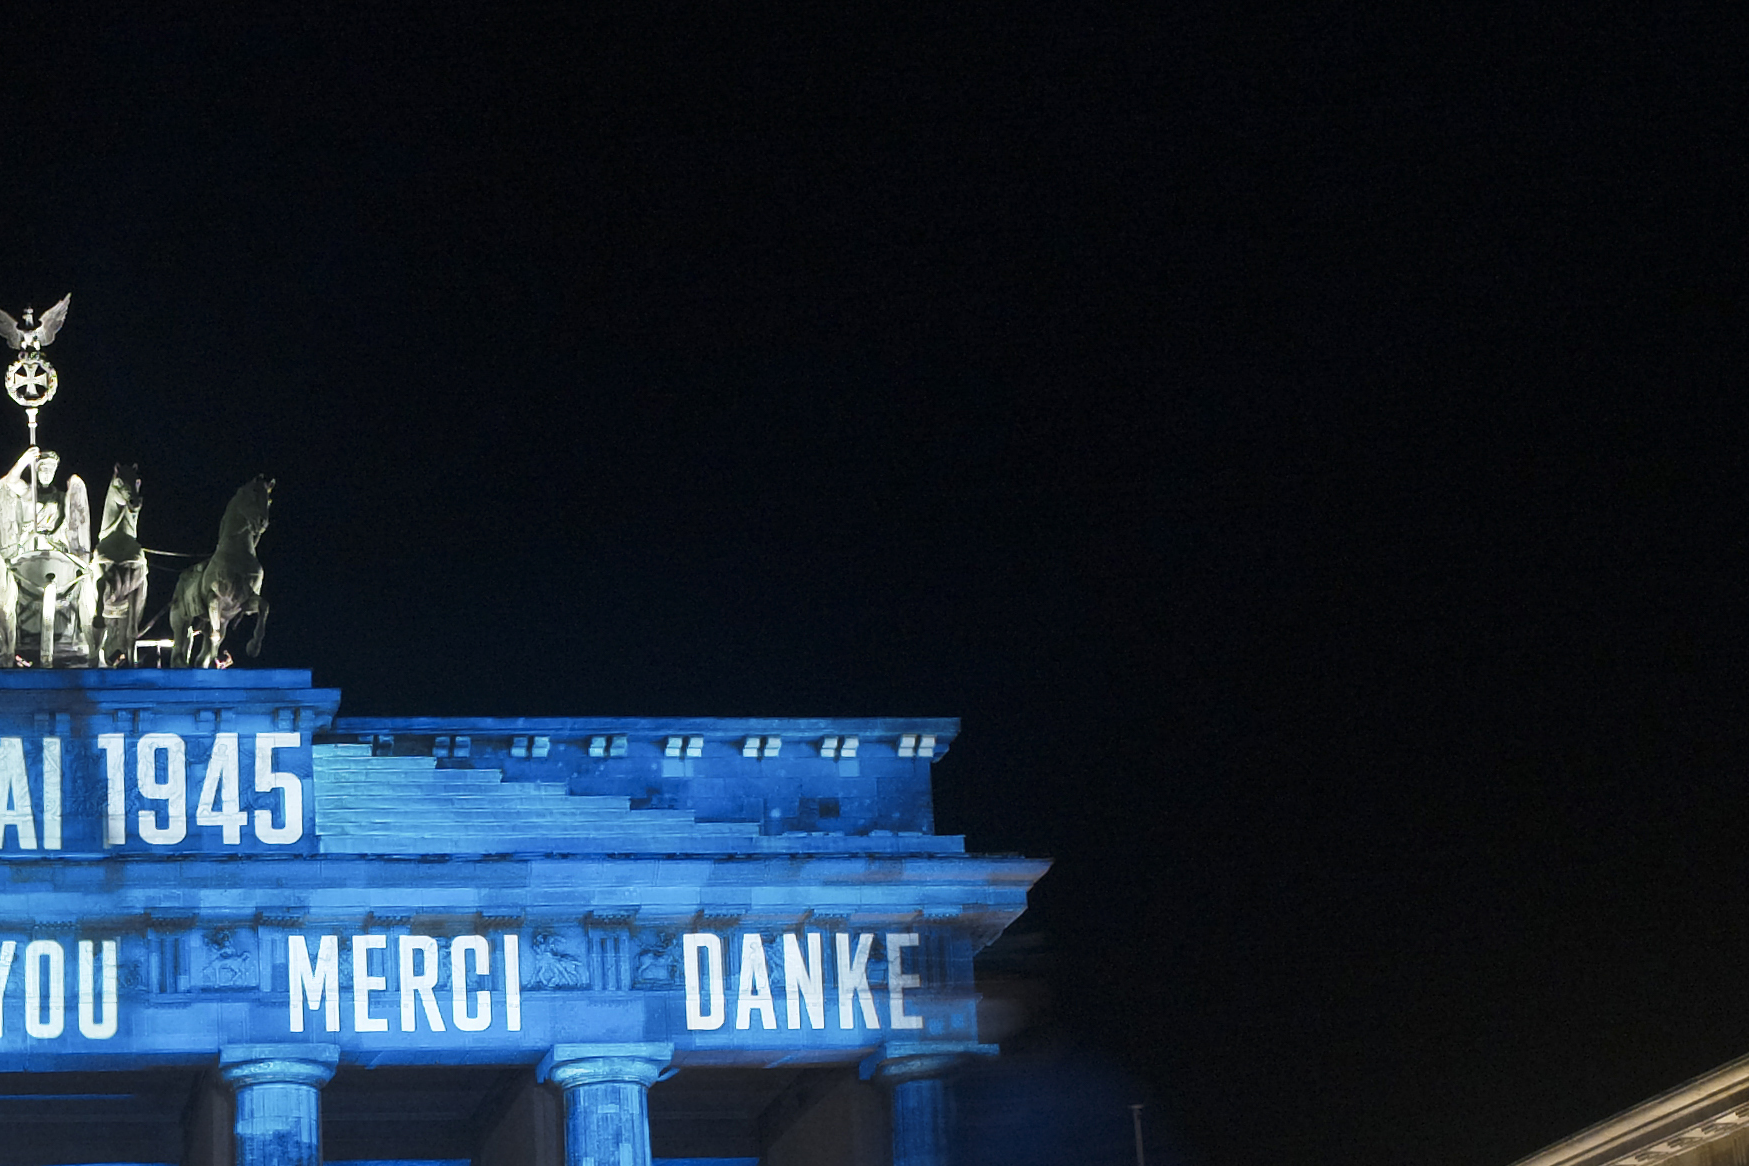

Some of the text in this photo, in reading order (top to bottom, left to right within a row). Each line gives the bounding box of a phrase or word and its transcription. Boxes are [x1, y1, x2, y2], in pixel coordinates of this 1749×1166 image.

[97, 732, 304, 845] 1945
[287, 934, 522, 1033] MERCI
[682, 932, 924, 1031] DANKE
